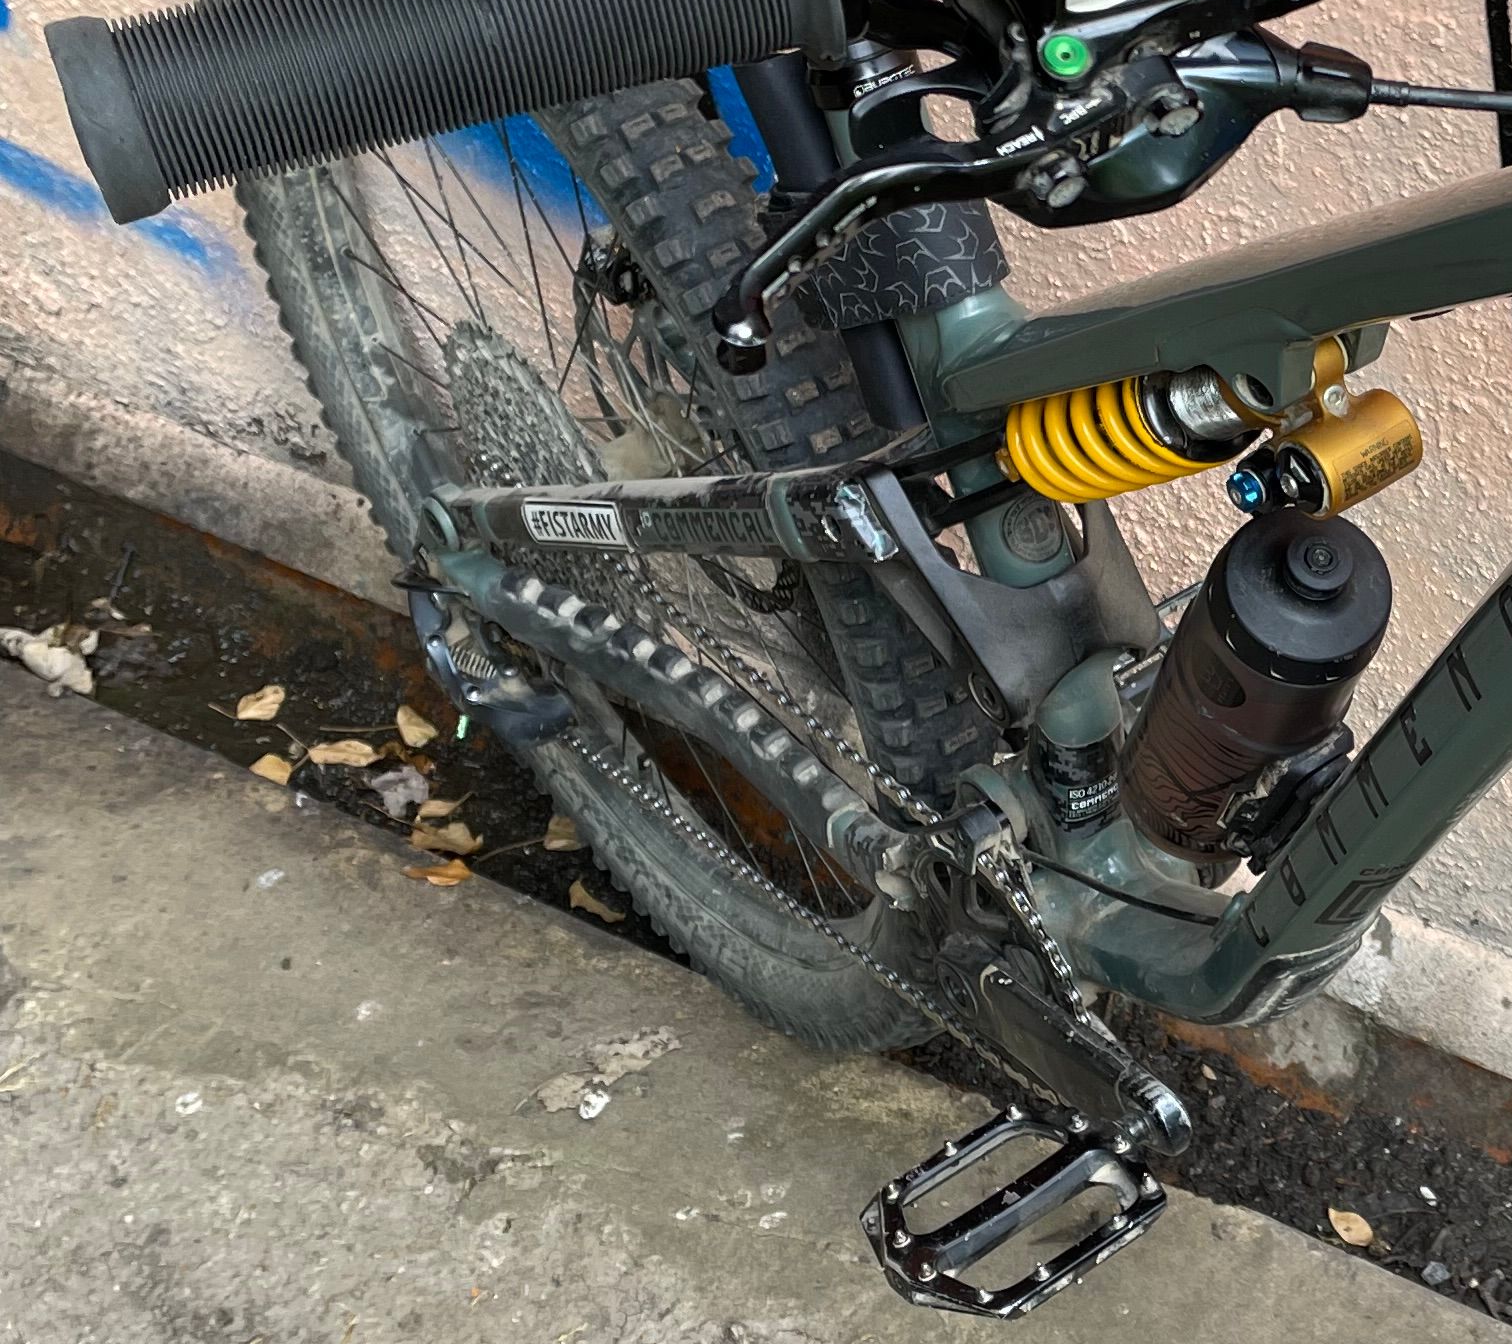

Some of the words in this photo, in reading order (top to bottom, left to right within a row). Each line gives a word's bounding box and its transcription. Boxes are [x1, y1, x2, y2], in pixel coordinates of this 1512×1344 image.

[996, 130, 1036, 156] REACH
[531, 510, 617, 541] #FISTARMY
[651, 510, 773, 544] COMMENCAL
[1069, 789, 1086, 799] ISO
[1071, 783, 1119, 810] COMMENC
